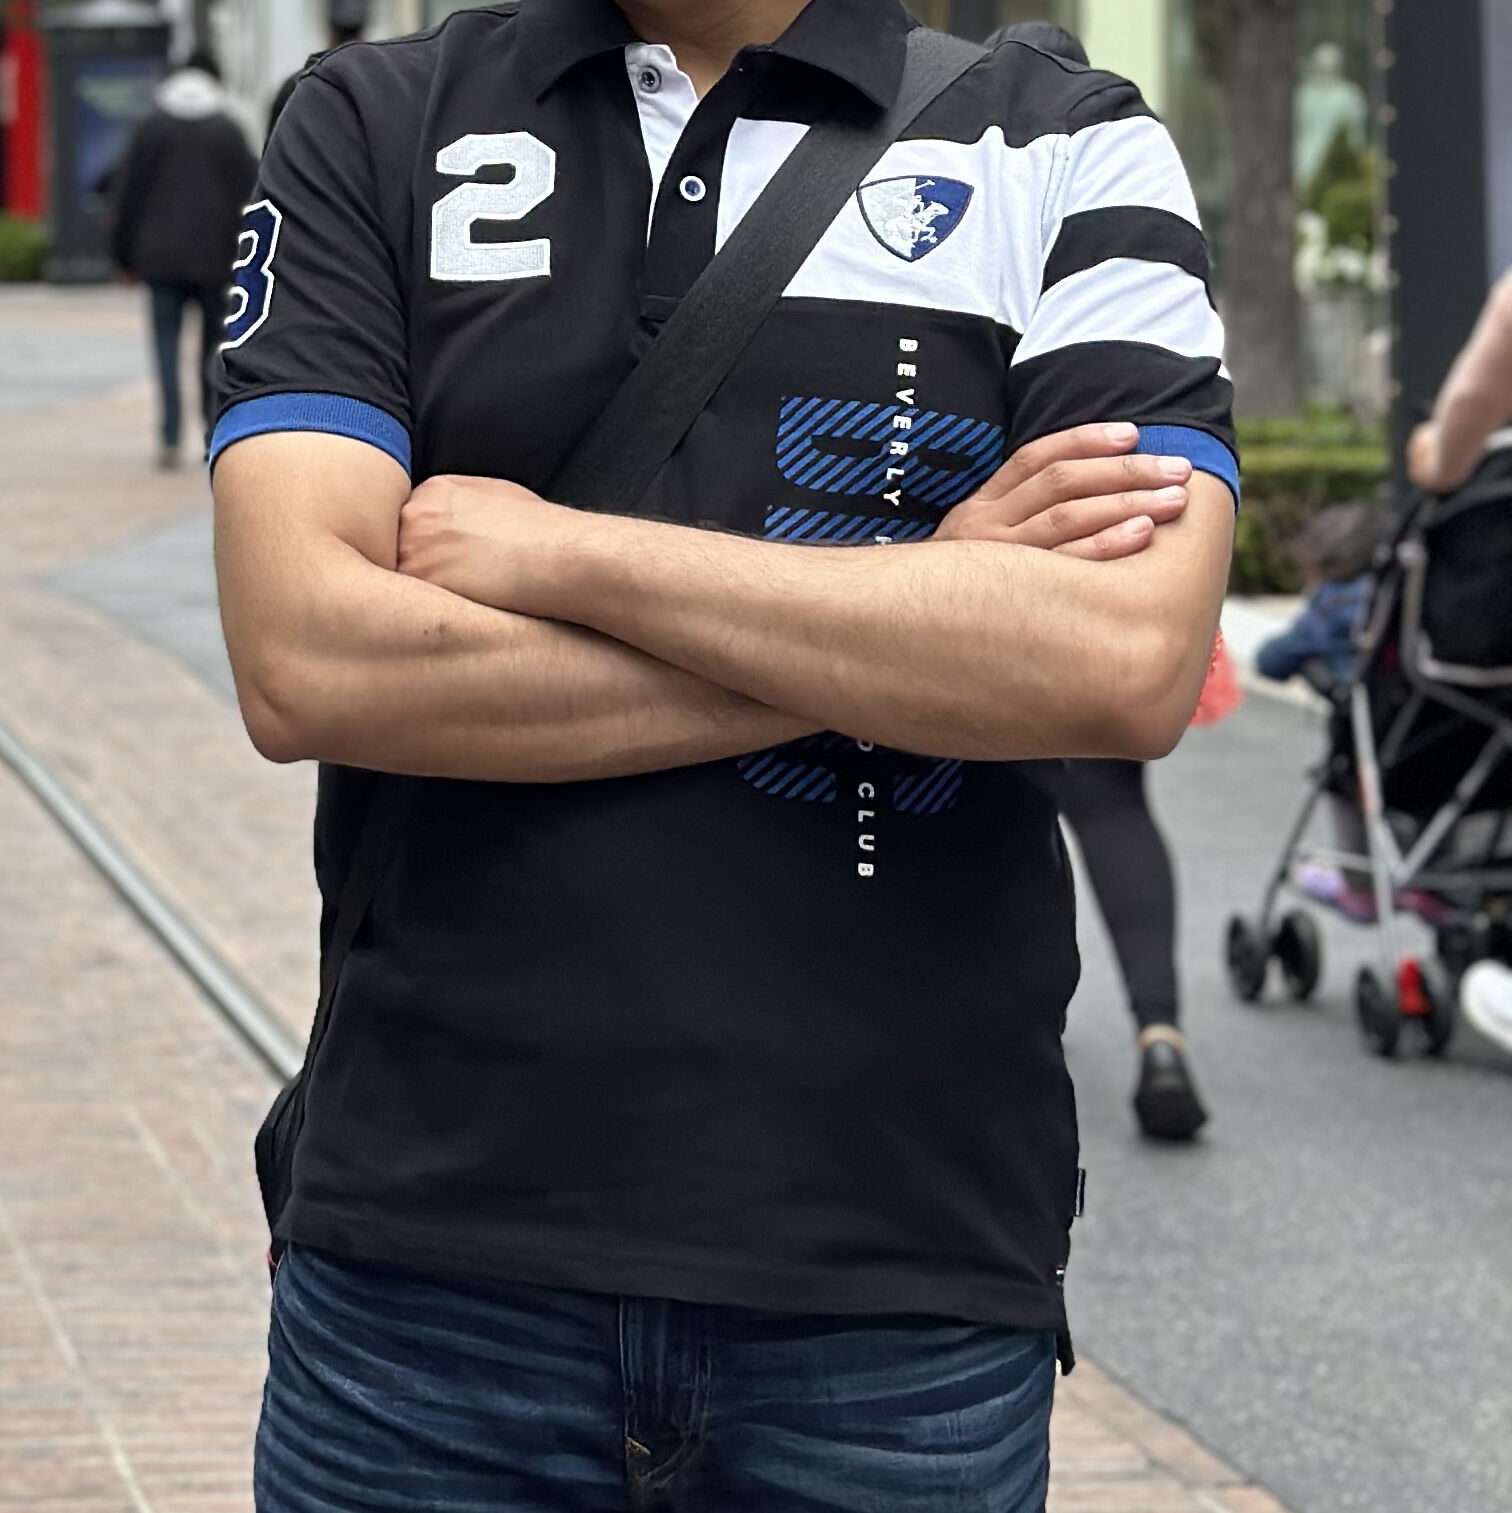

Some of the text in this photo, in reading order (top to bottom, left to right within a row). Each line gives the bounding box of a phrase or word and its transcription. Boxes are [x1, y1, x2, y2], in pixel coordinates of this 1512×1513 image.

[430, 131, 556, 282] 2
[883, 338, 918, 506] BEVERLY
[857, 782, 875, 877] CLUB
